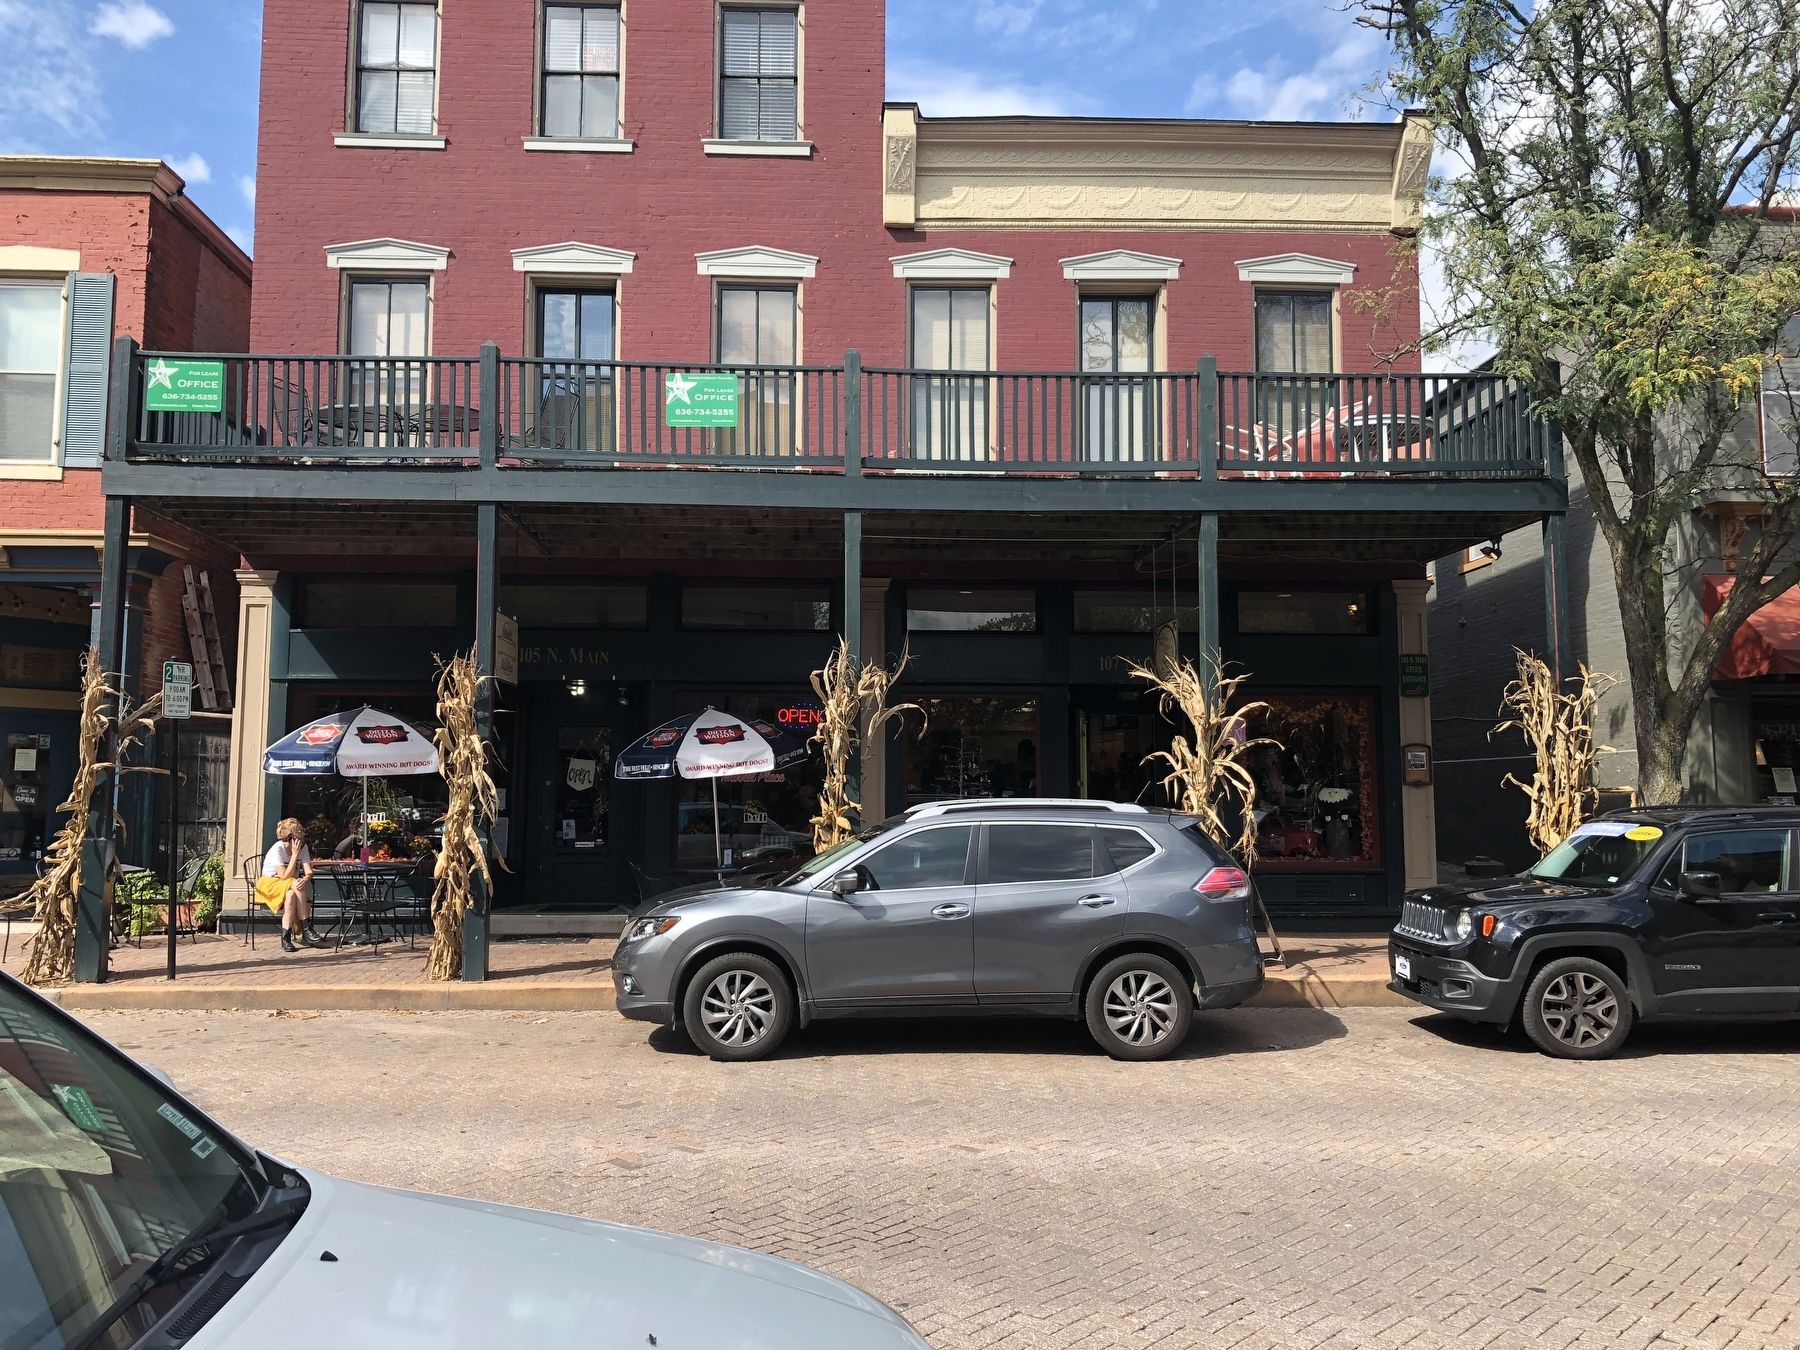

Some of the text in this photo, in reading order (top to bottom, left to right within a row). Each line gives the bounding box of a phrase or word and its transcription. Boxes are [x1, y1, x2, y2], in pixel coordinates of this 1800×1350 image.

[177, 378, 218, 388] OFFICE
[162, 392, 218, 400] 636-734-5255
[520, 647, 609, 664] 105 N. MAIN
[1099, 655, 1120, 672] 107
[166, 666, 172, 680] 2
[778, 708, 820, 723] OPEN
[706, 762, 734, 771] WINNING
[736, 760, 748, 768] HOT
[749, 758, 768, 766] DOGS!
[15, 795, 35, 804] OPEN
[744, 812, 768, 824] Deli
